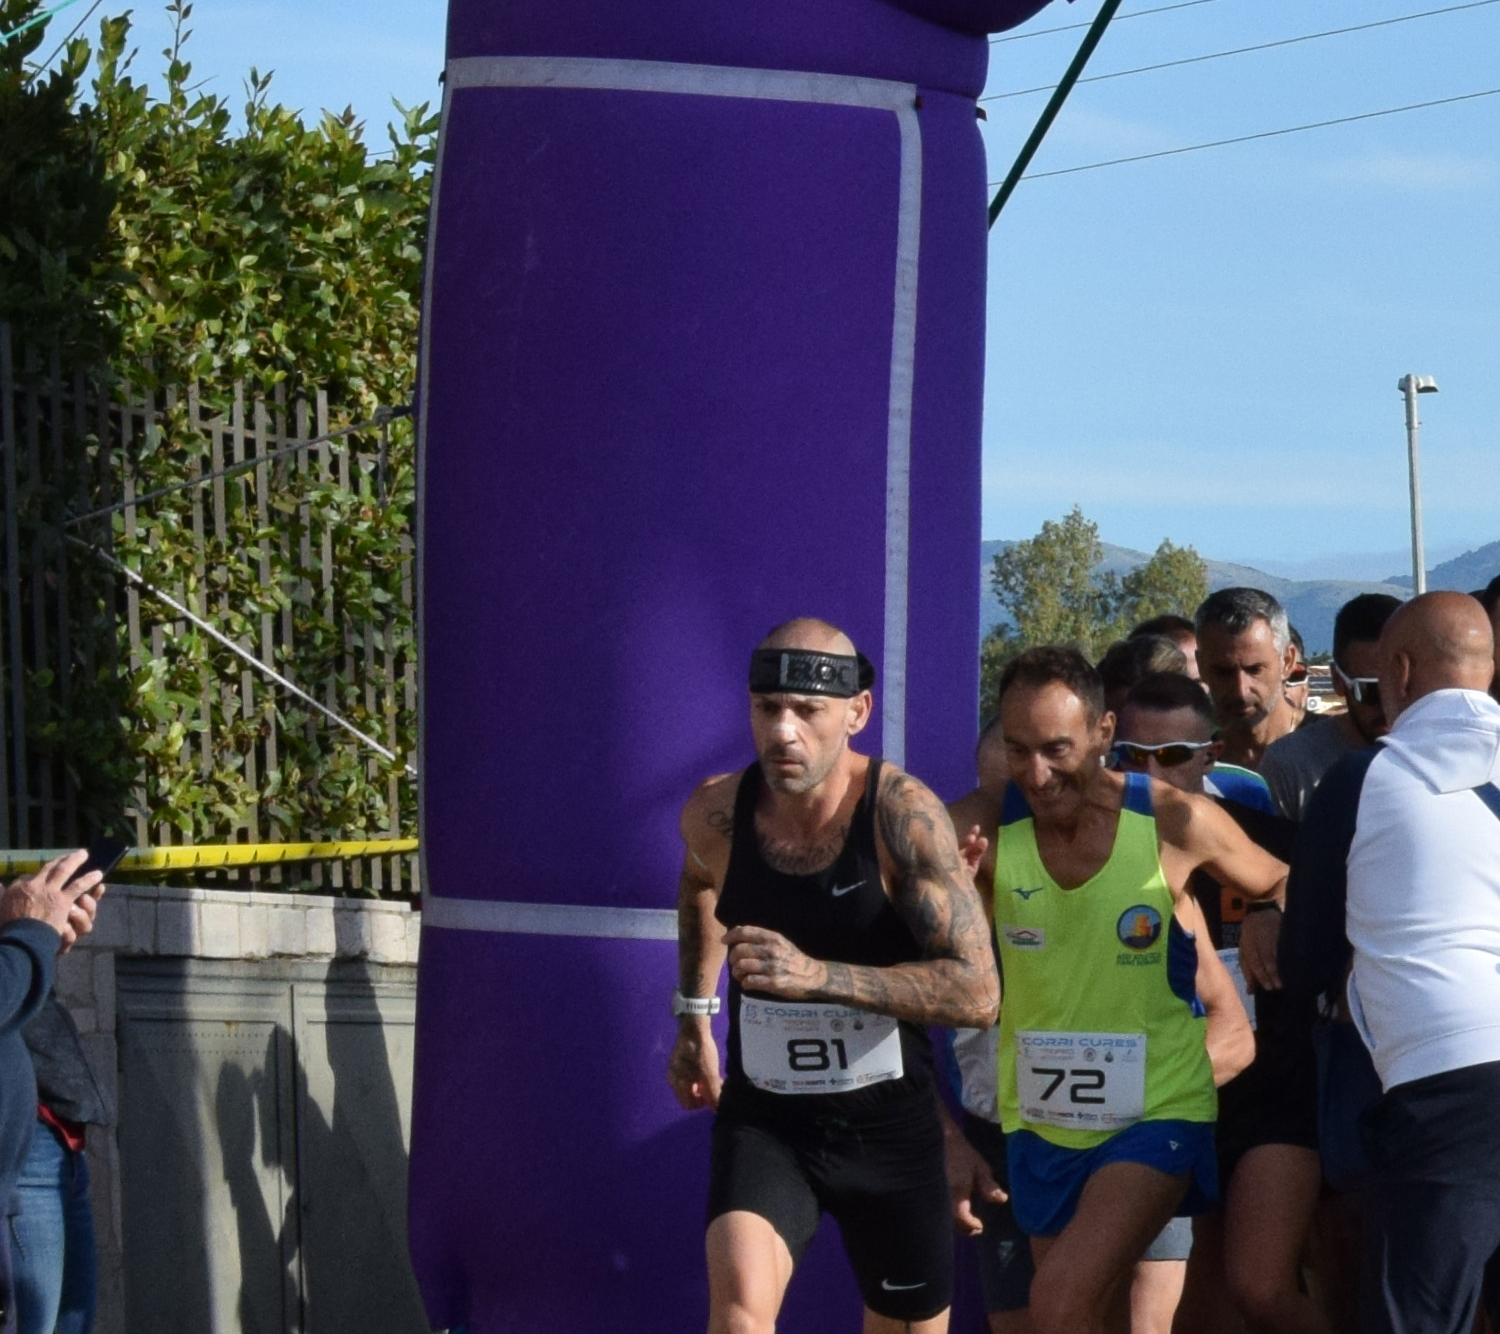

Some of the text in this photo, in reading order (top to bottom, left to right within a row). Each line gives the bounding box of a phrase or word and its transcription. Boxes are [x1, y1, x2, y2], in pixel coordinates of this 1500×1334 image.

[764, 1006, 818, 1018] CORRI
[1022, 1037, 1138, 1048] CORRI CURES
[787, 1038, 848, 1071] 81
[1031, 1067, 1106, 1104] 72
